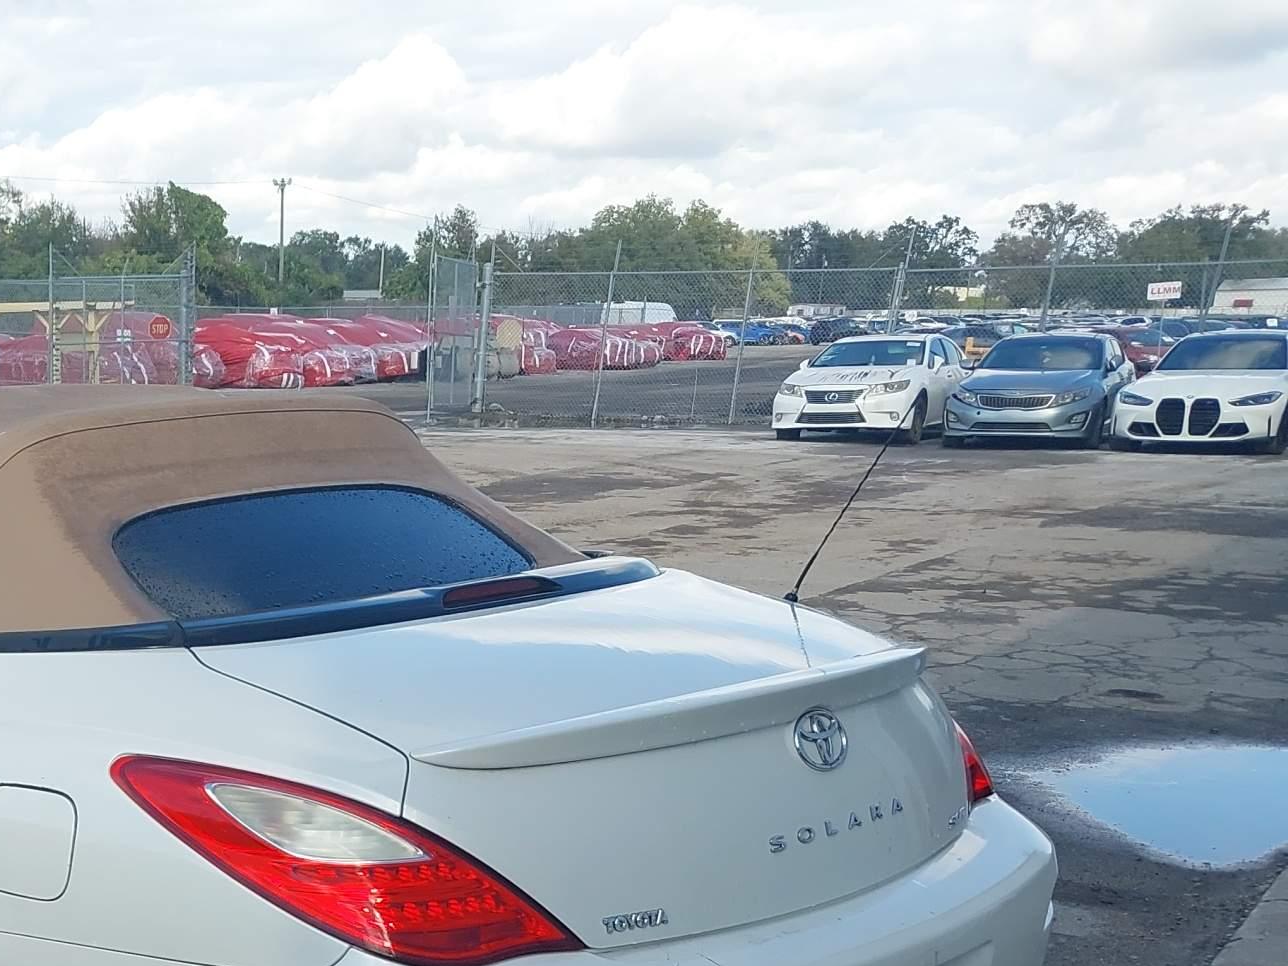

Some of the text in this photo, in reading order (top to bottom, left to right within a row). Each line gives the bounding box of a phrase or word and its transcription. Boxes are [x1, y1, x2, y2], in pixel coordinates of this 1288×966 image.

[152, 323, 169, 335] STOP
[768, 797, 904, 854] SOLARA
[602, 908, 669, 934] TOYOTA
